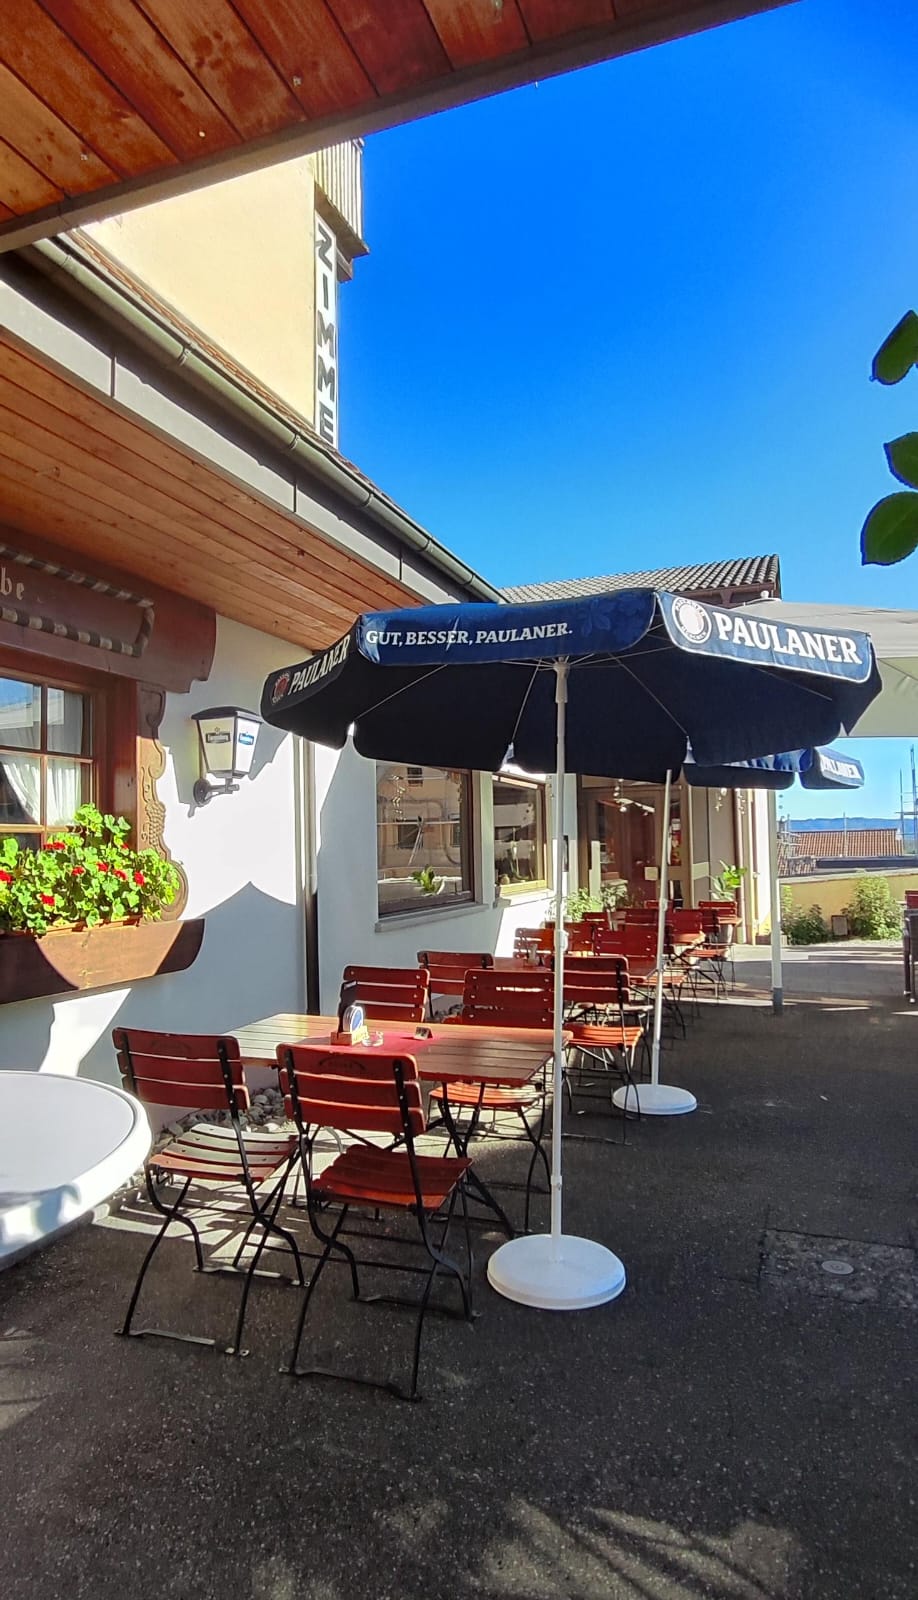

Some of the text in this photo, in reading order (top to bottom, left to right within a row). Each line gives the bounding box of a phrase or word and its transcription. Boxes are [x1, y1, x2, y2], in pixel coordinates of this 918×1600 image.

[366, 622, 573, 647] GUT, BESSER, PAULANER.
[712, 611, 863, 665] PAULANER
[287, 634, 351, 696] PAULANER
